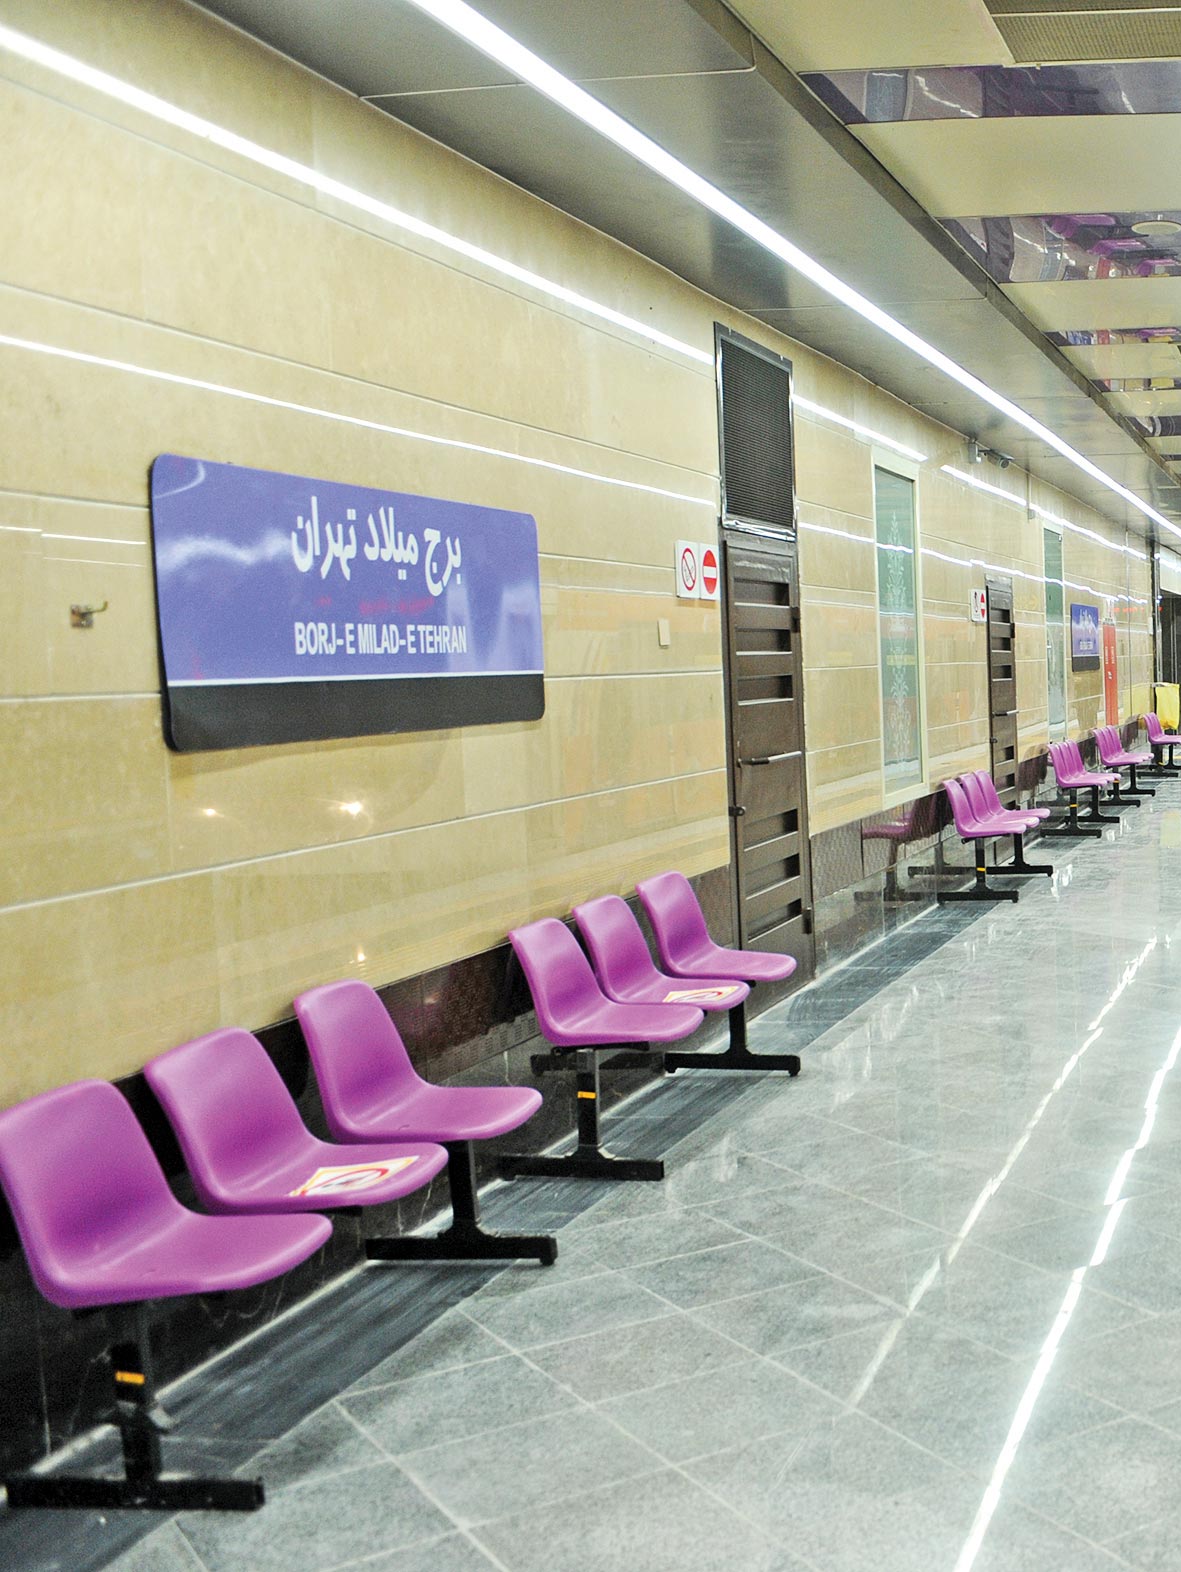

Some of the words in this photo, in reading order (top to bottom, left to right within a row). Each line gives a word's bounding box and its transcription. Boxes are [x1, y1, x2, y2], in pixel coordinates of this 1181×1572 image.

[291, 495, 357, 580] تهران
[364, 506, 419, 581] میلاد
[424, 527, 462, 596] برج
[418, 625, 467, 654] TEHRAN
